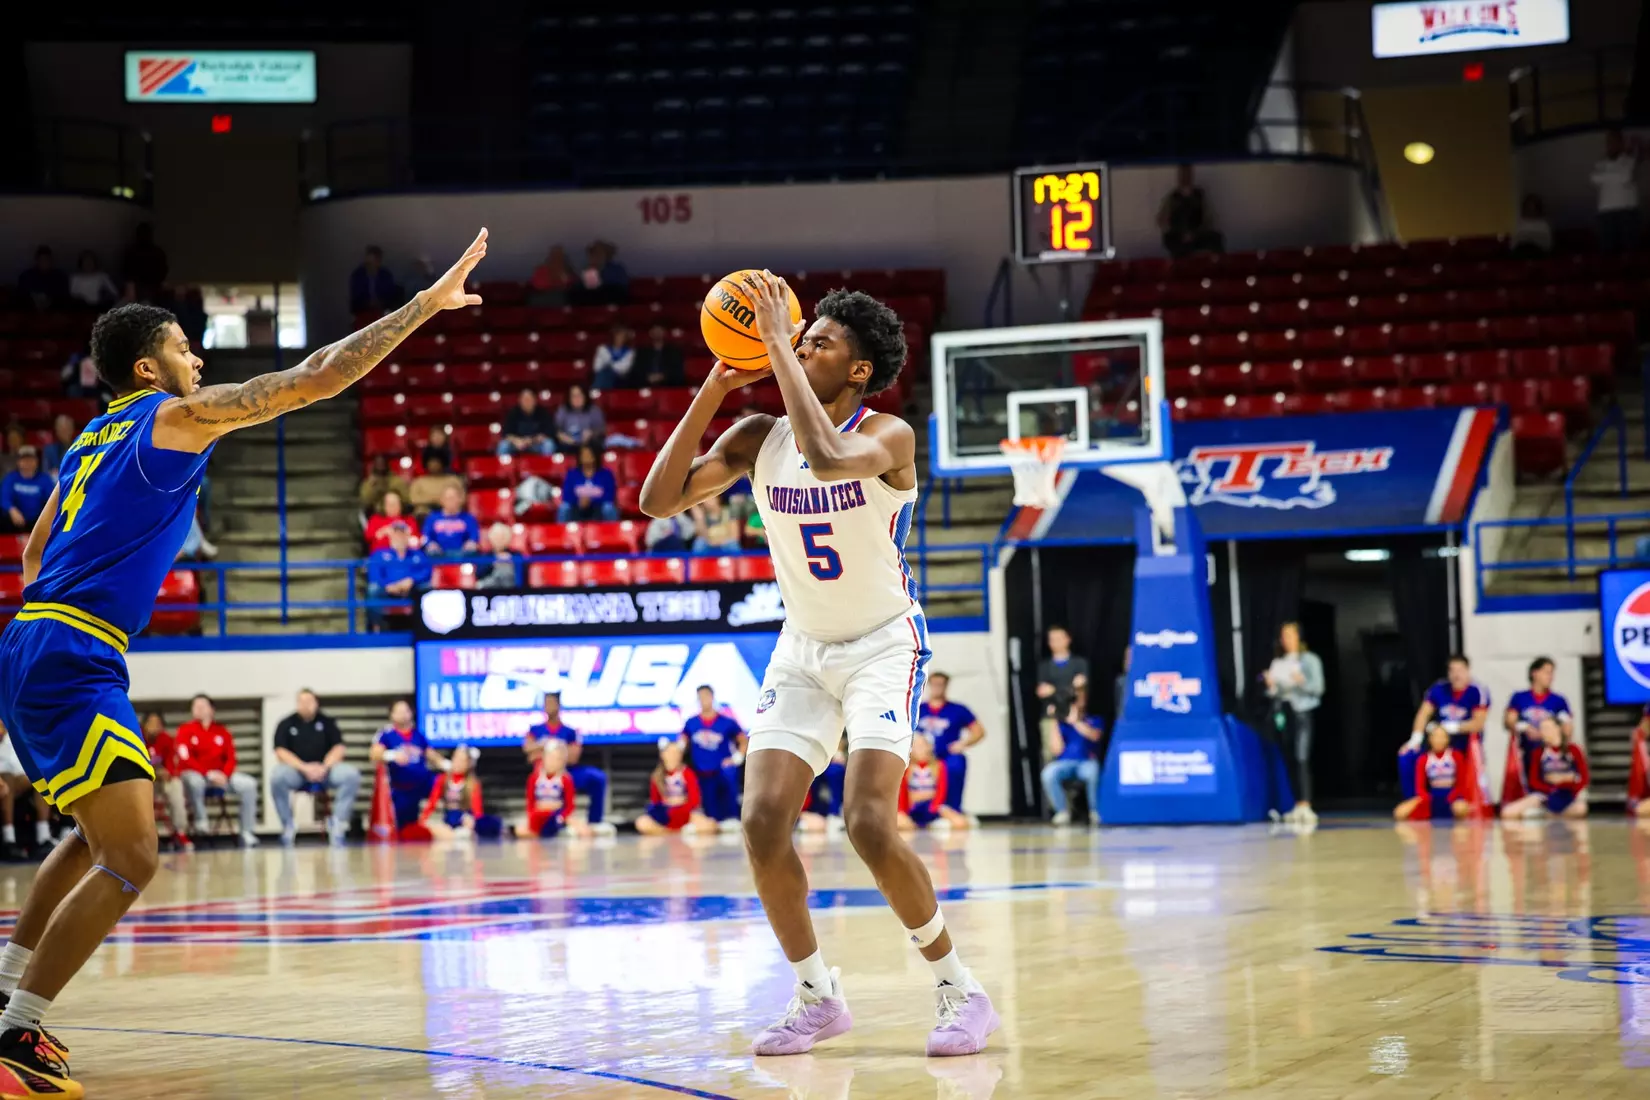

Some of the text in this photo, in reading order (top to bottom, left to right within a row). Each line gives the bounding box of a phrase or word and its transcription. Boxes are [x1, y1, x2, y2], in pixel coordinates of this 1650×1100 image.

[1034, 172, 1099, 204] 17:27
[636, 195, 692, 225] 105
[1051, 200, 1093, 250] 12
[713, 287, 756, 330] Wilso
[68, 420, 136, 452] FERNNDEZ
[61, 451, 106, 532] 4
[766, 480, 866, 514] LOUISIANA TECH
[799, 522, 843, 581] 5
